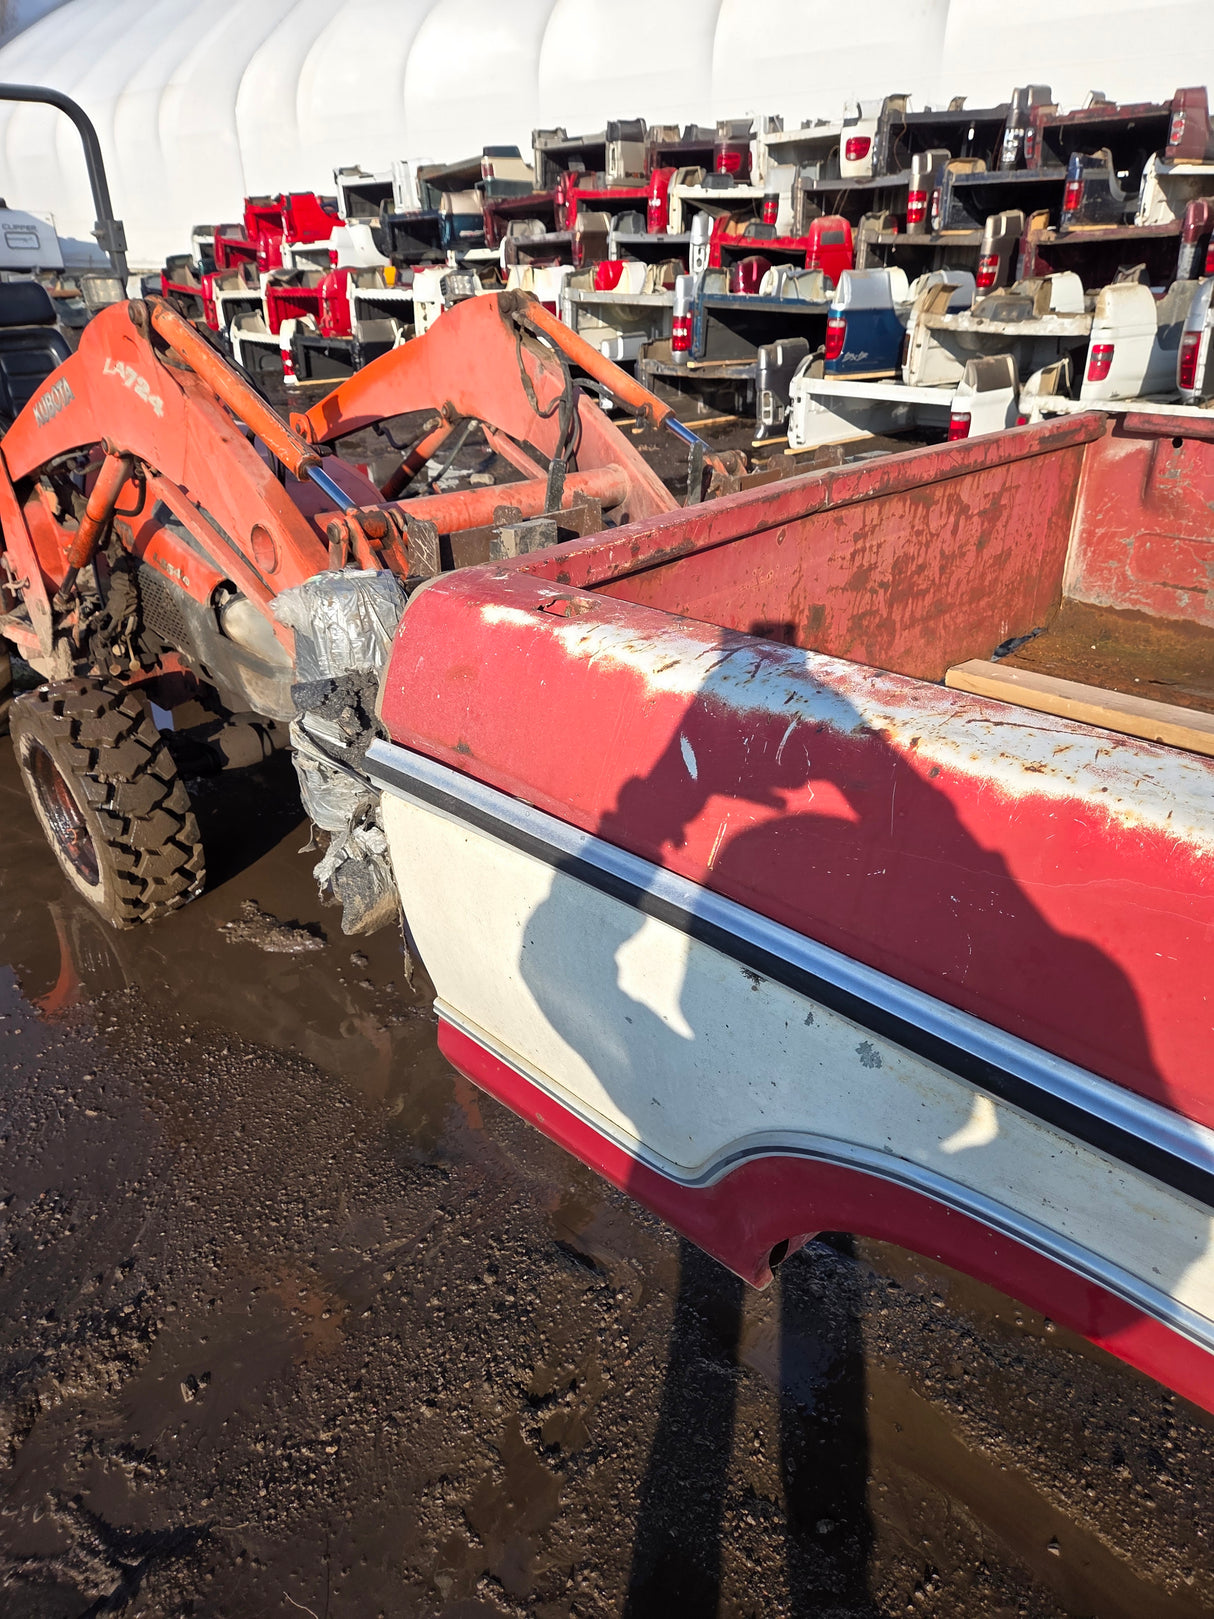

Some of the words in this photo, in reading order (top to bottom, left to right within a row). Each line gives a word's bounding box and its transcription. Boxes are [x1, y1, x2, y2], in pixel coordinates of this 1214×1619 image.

[2, 223, 37, 231] CLIPPER
[32, 376, 76, 428] KUBOTA
[102, 357, 165, 418] LA724
